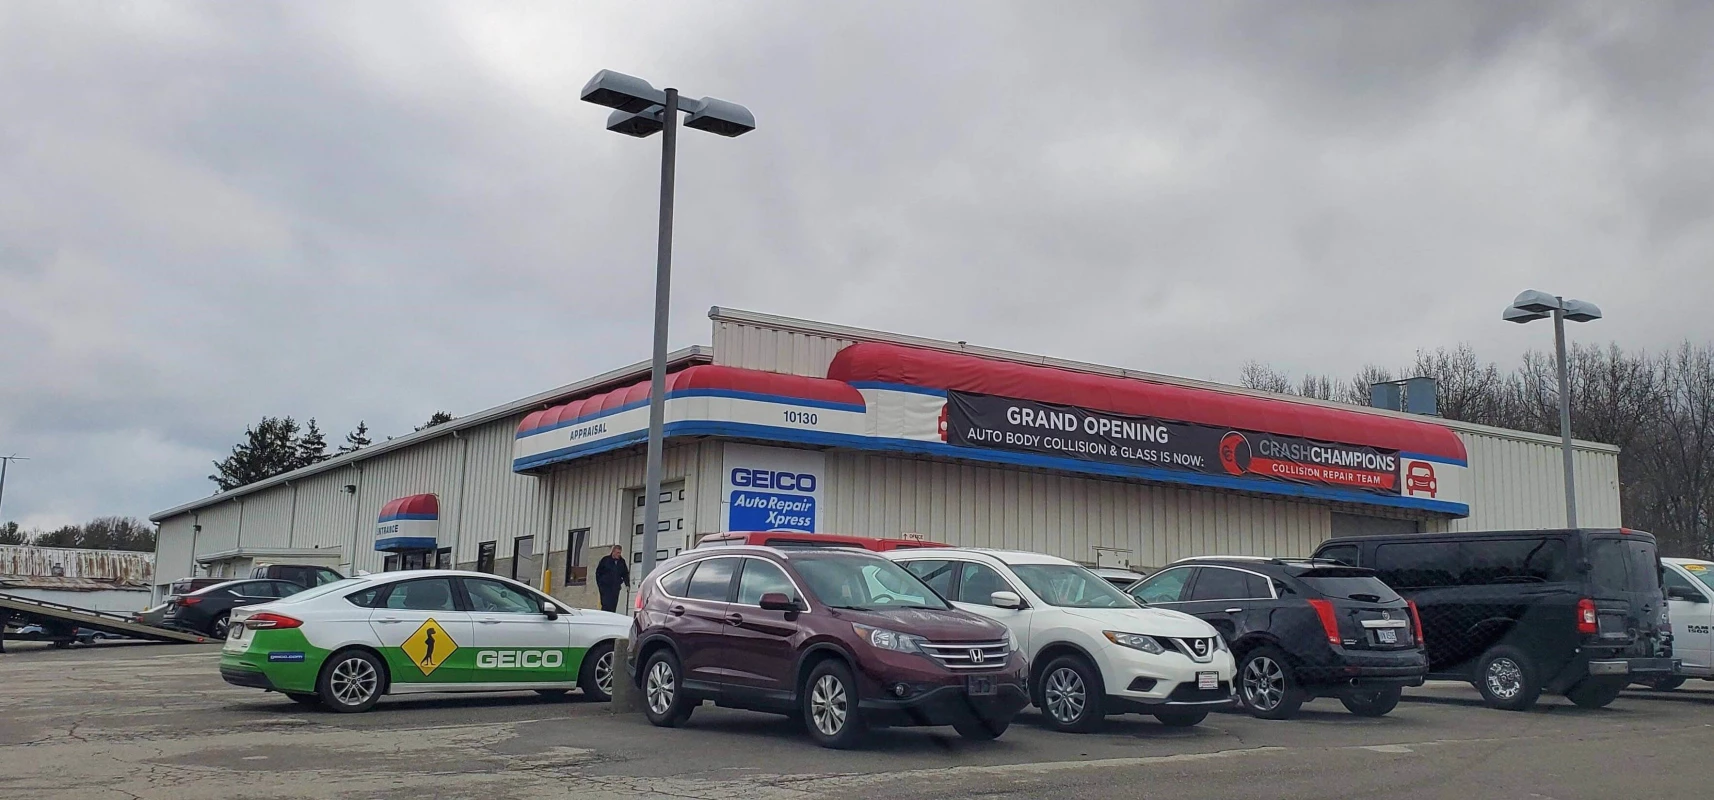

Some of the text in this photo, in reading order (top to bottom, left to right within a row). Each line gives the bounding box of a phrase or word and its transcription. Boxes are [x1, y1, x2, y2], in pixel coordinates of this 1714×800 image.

[784, 410, 818, 425] 10130
[1006, 406, 1168, 444] GRAND OPENING
[570, 422, 607, 441] APPRAISAL
[967, 427, 1204, 467] AUTO BODY COLLISION & GLASS IS NOW:
[731, 468, 816, 492] GEICO
[1272, 463, 1381, 485] COLLISION REPAIR TEAM
[734, 494, 812, 513] Auto Repair
[765, 511, 811, 527] Xpress
[476, 650, 563, 668] GEICO
